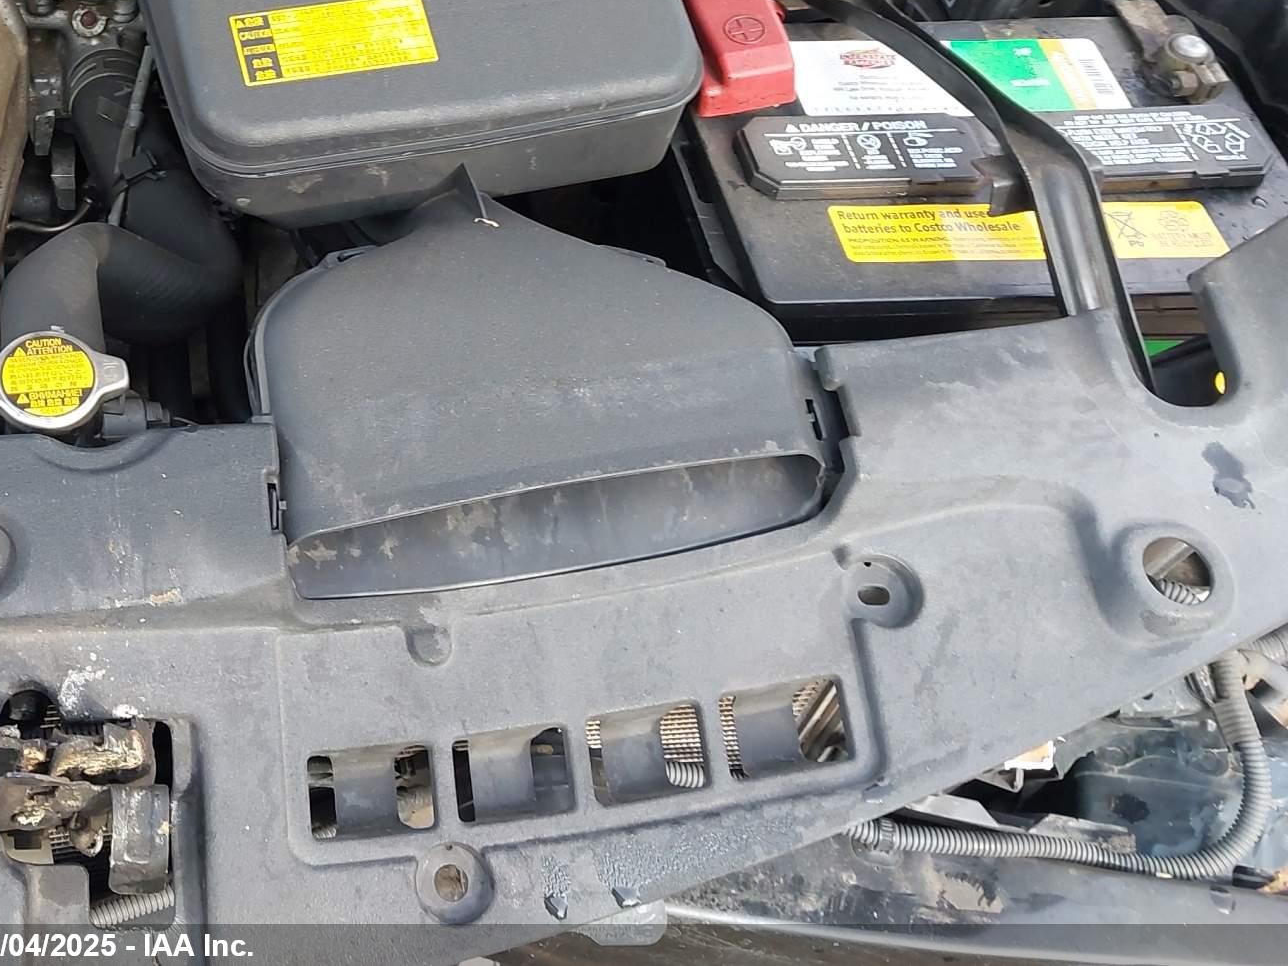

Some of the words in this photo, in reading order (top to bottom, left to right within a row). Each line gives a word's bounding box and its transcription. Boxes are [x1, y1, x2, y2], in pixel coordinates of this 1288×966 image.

[798, 121, 860, 133] DANGER
[870, 120, 928, 131] POISON
[837, 210, 878, 221] Return
[880, 209, 936, 222] warranty
[939, 208, 962, 219] and
[843, 223, 897, 234] batteries
[899, 223, 912, 233] to
[915, 222, 953, 233] Costco
[955, 221, 1021, 233] Wholesale
[25, 338, 61, 348] CAUTION
[27, 345, 73, 356] ATTENTION
